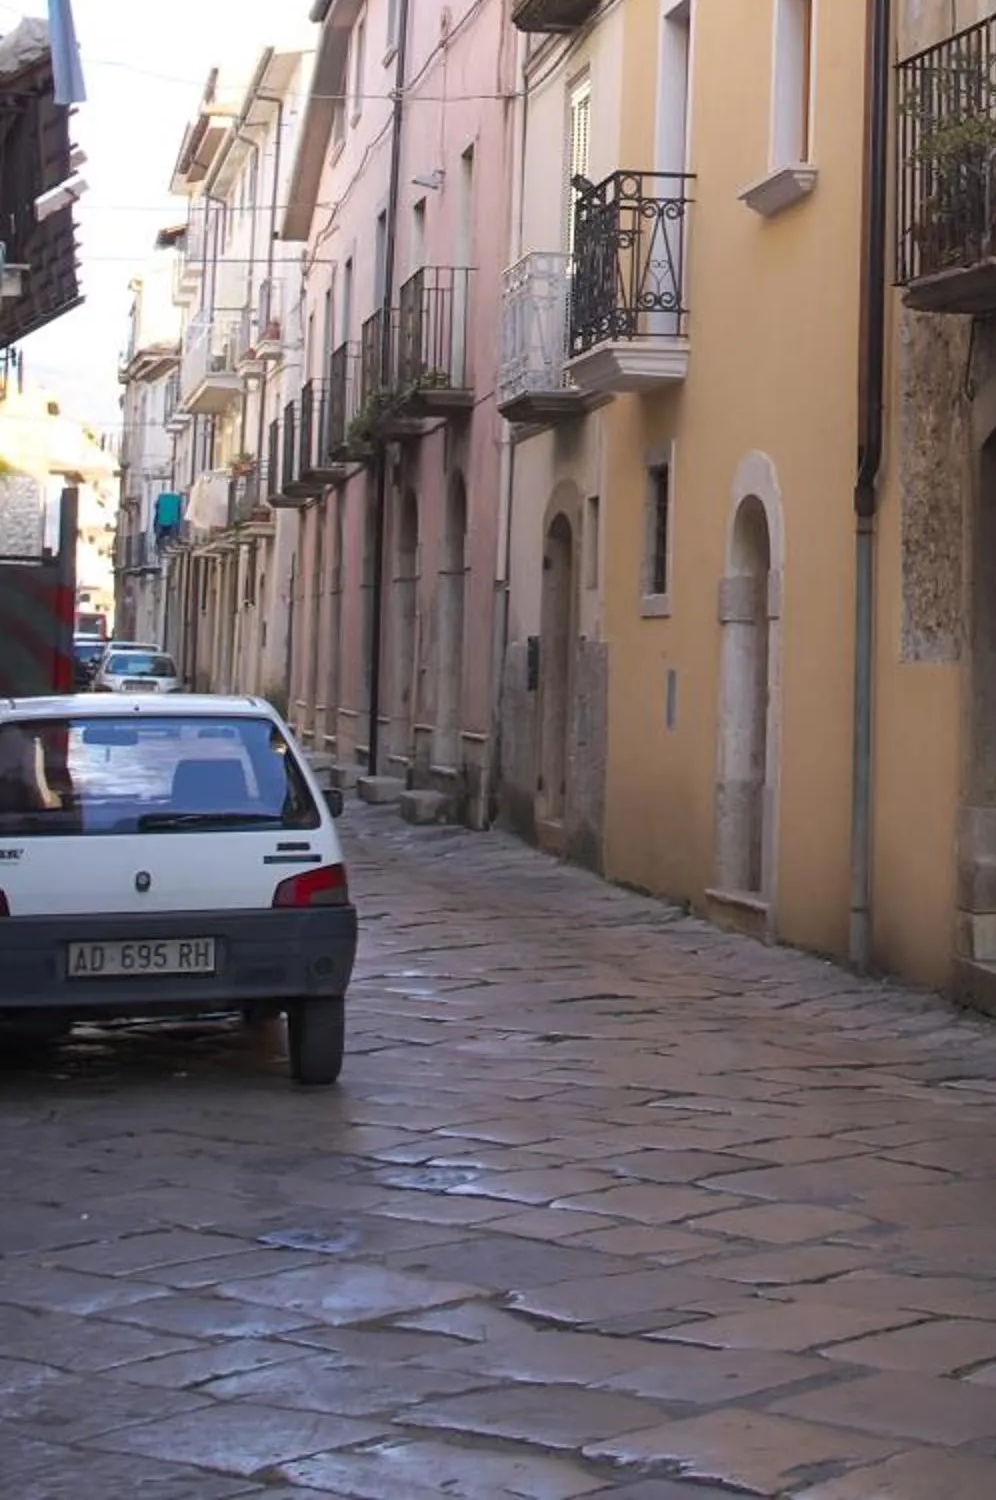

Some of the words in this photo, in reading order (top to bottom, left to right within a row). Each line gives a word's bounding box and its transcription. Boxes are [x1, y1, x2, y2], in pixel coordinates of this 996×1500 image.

[74, 945, 105, 973] AD
[120, 943, 168, 970] 695
[178, 941, 210, 969] RH
